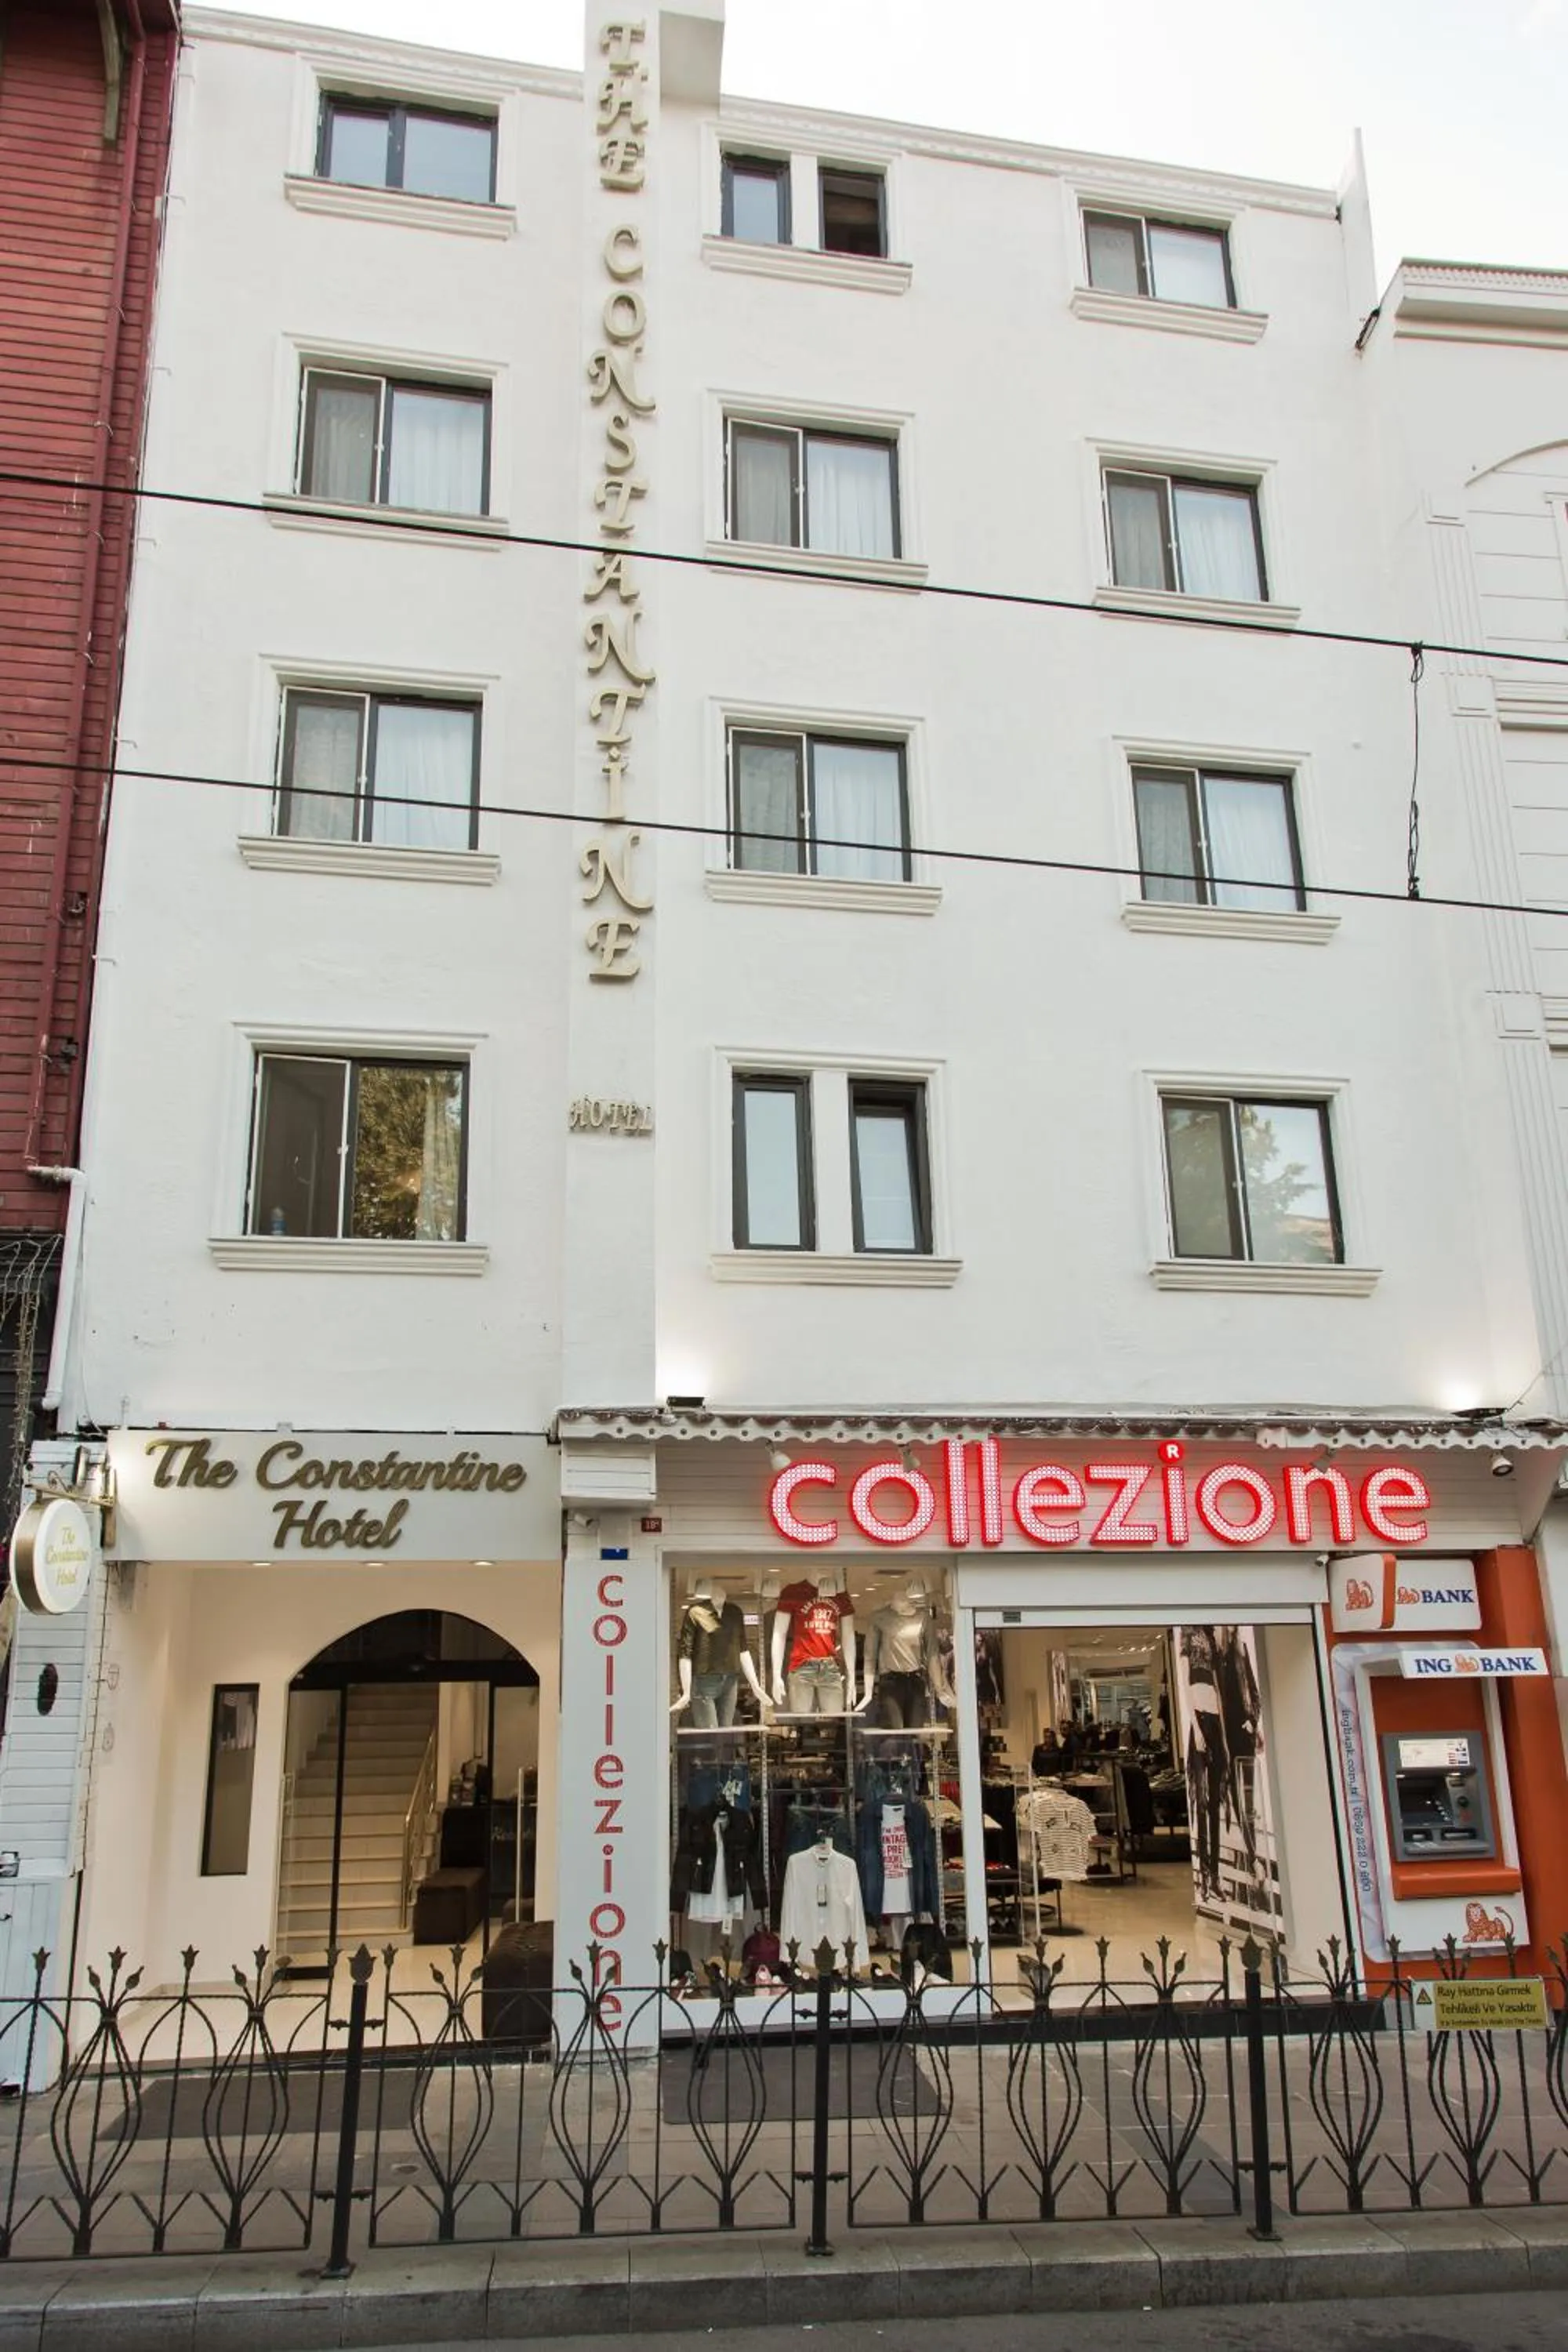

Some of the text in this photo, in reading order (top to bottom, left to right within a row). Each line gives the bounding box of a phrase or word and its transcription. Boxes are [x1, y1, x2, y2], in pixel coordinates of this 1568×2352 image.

[597, 21, 648, 192] THE
[569, 1094, 653, 1135] HOTEL
[146, 1438, 528, 1491] The Constantine
[769, 1438, 1432, 1546] collezione
[273, 1498, 409, 1549] Hotel
[1421, 1589, 1474, 1603] BANK
[1415, 1656, 1537, 1673] ING BANK
[589, 1574, 628, 2031] collezione
[1437, 1986, 1456, 1998] Ray
[1497, 1984, 1531, 1995] Girmek
[1483, 2002, 1496, 2013] Ve
